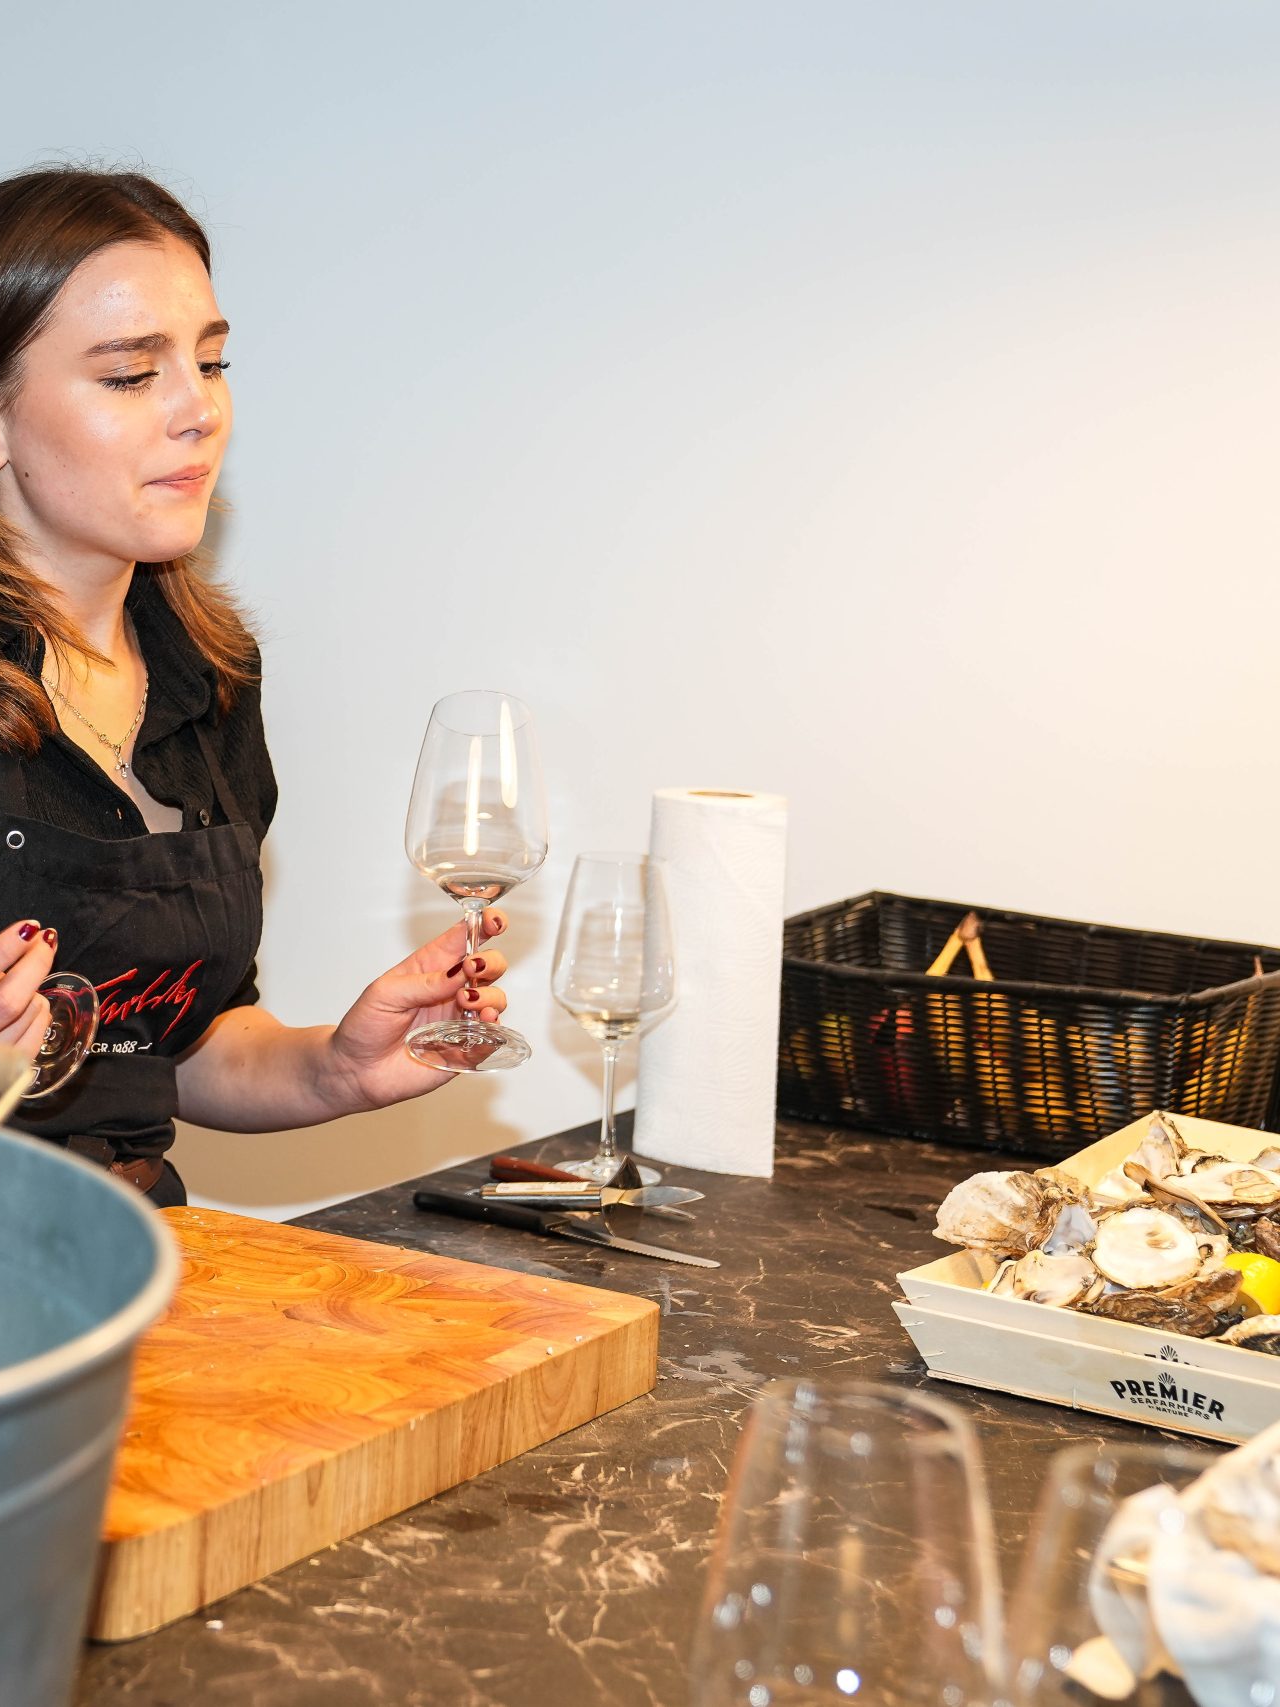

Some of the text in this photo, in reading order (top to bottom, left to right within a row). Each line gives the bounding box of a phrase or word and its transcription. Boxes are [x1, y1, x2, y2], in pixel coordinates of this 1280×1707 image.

[1110, 1379, 1226, 1422] PREMIER
[1130, 1397, 1211, 1421] SEAFARMERS
[1156, 1406, 1190, 1418] NATURE
